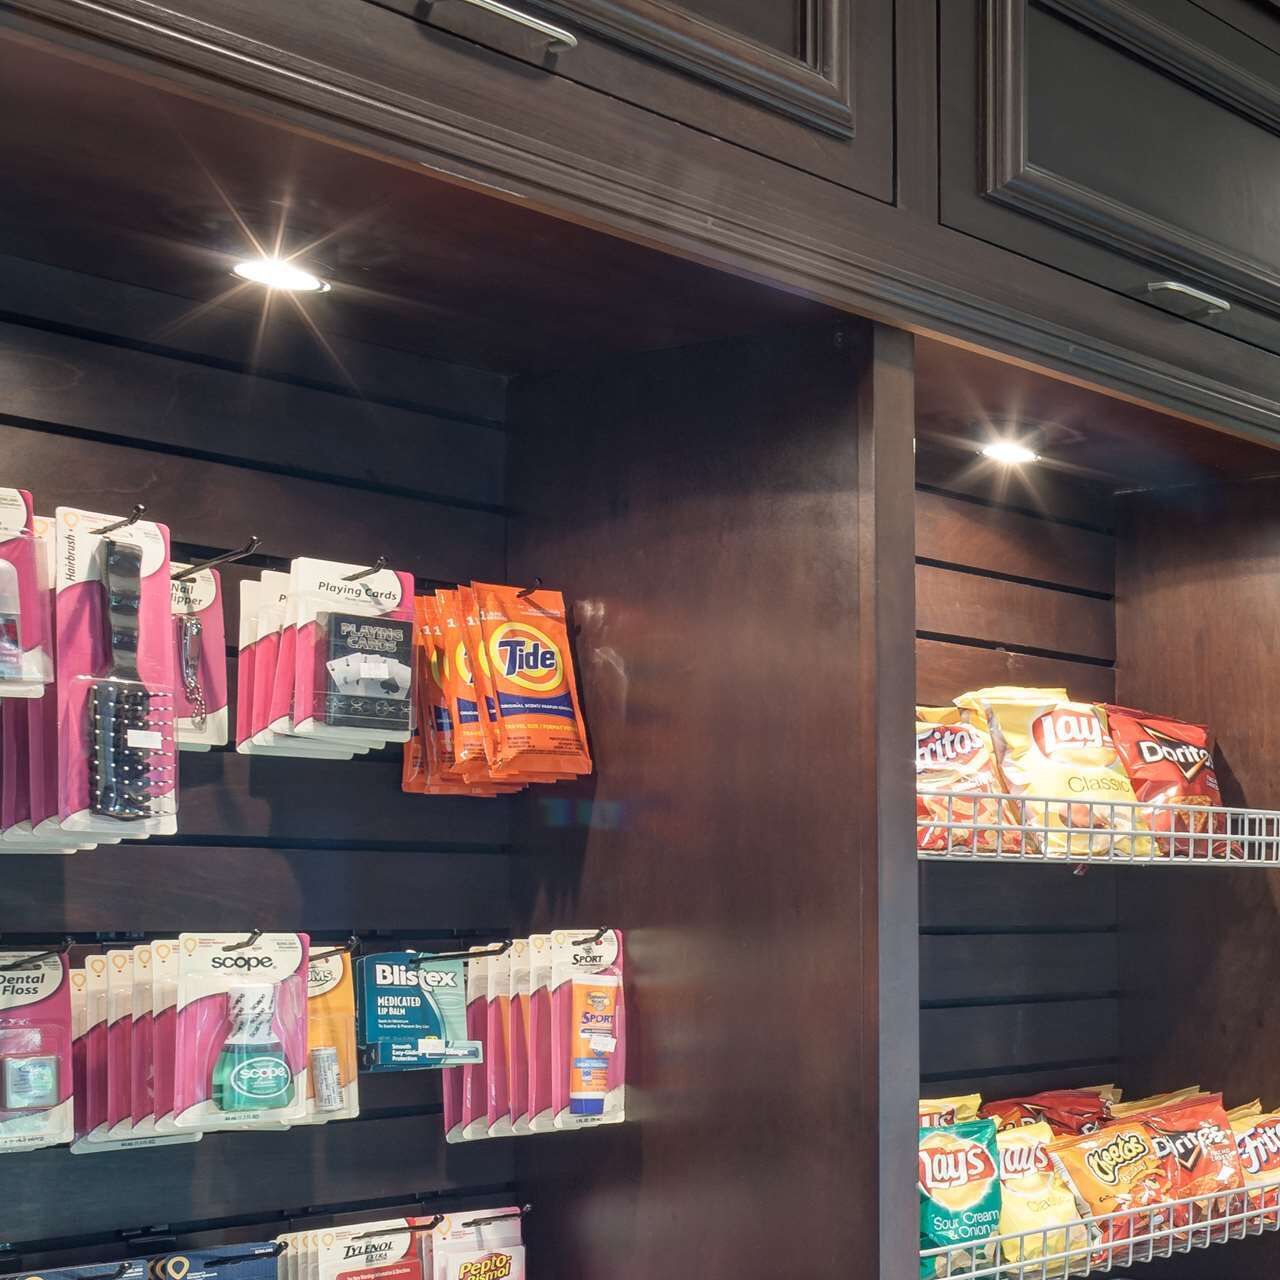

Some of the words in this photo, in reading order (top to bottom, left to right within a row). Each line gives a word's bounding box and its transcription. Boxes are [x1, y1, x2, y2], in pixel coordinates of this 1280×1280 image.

[65, 534, 77, 582] Hairbrush
[318, 581, 362, 598] Playing
[365, 587, 398, 601] Cards
[172, 594, 204, 608] lipper
[340, 622, 404, 642] PLAYING
[346, 636, 397, 652] CARDS
[498, 639, 556, 677] Tide
[1067, 775, 1131, 792] Classic
[212, 955, 273, 972] scope
[571, 954, 604, 966] SPORT
[0, 973, 45, 985] Dental
[307, 969, 332, 982] UMS
[376, 964, 457, 992] Blistex
[2, 984, 39, 996] Floss
[377, 996, 421, 1007] MEDICATED
[378, 1007, 388, 1016] LIP
[389, 1006, 406, 1016] BALM
[581, 1011, 614, 1025] SPORT
[239, 1068, 286, 1082] scope
[1086, 1134, 1148, 1185] Cheetos
[934, 1217, 959, 1230] Sour
[962, 1209, 999, 1225] Cream
[949, 1229, 960, 1240] &
[957, 1223, 991, 1238] Onion
[343, 1241, 393, 1260] TYLENOL
[460, 1255, 512, 1279] Pepto-
